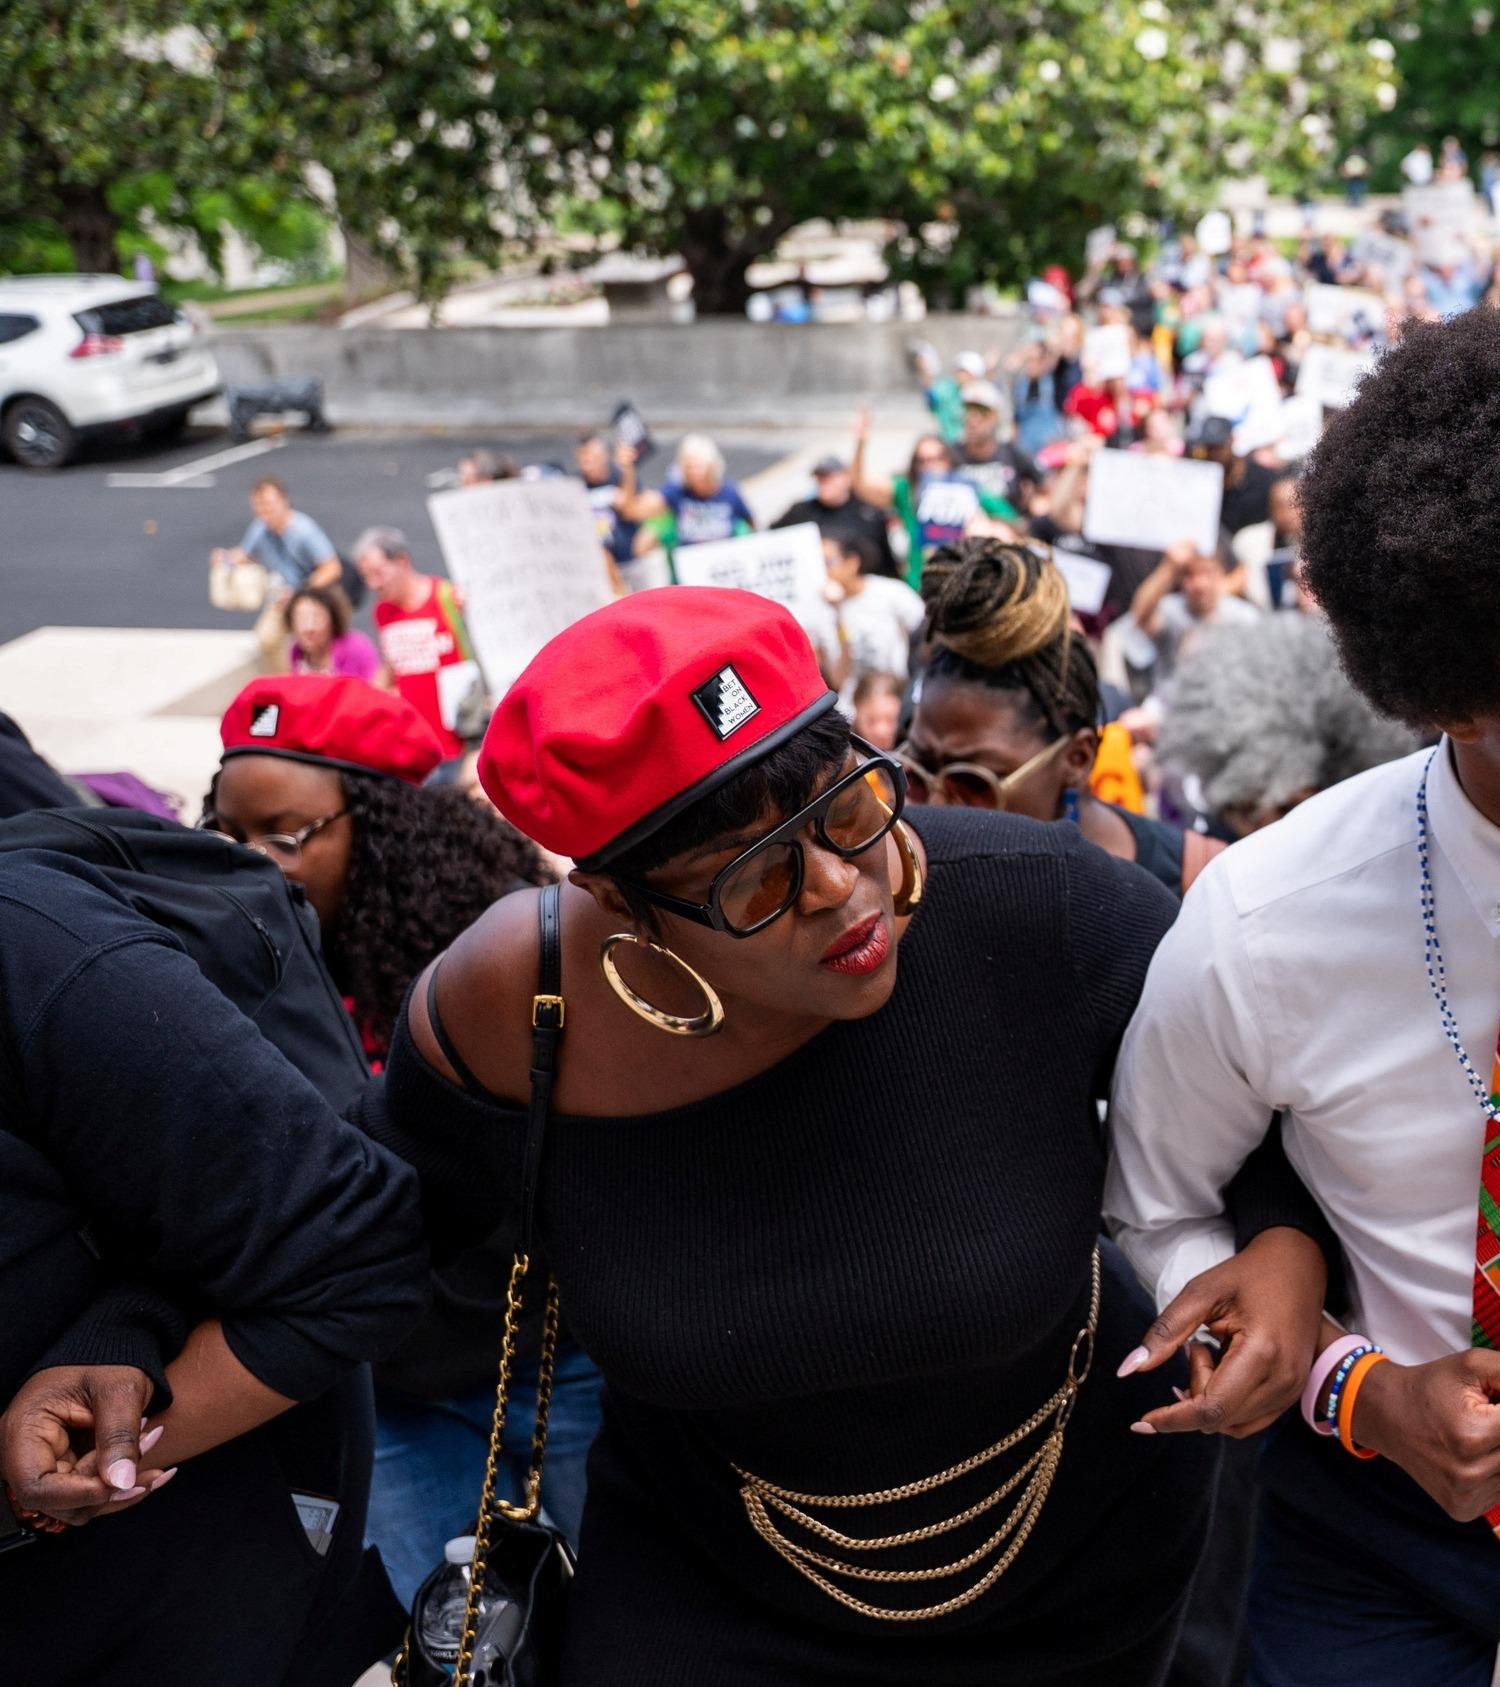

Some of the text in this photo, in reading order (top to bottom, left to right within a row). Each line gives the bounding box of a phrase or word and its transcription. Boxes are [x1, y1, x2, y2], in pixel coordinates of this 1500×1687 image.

[722, 679, 737, 693] BET
[731, 685, 743, 697] ON
[724, 696, 748, 715] BLACK
[728, 703, 754, 724] WOMEN
